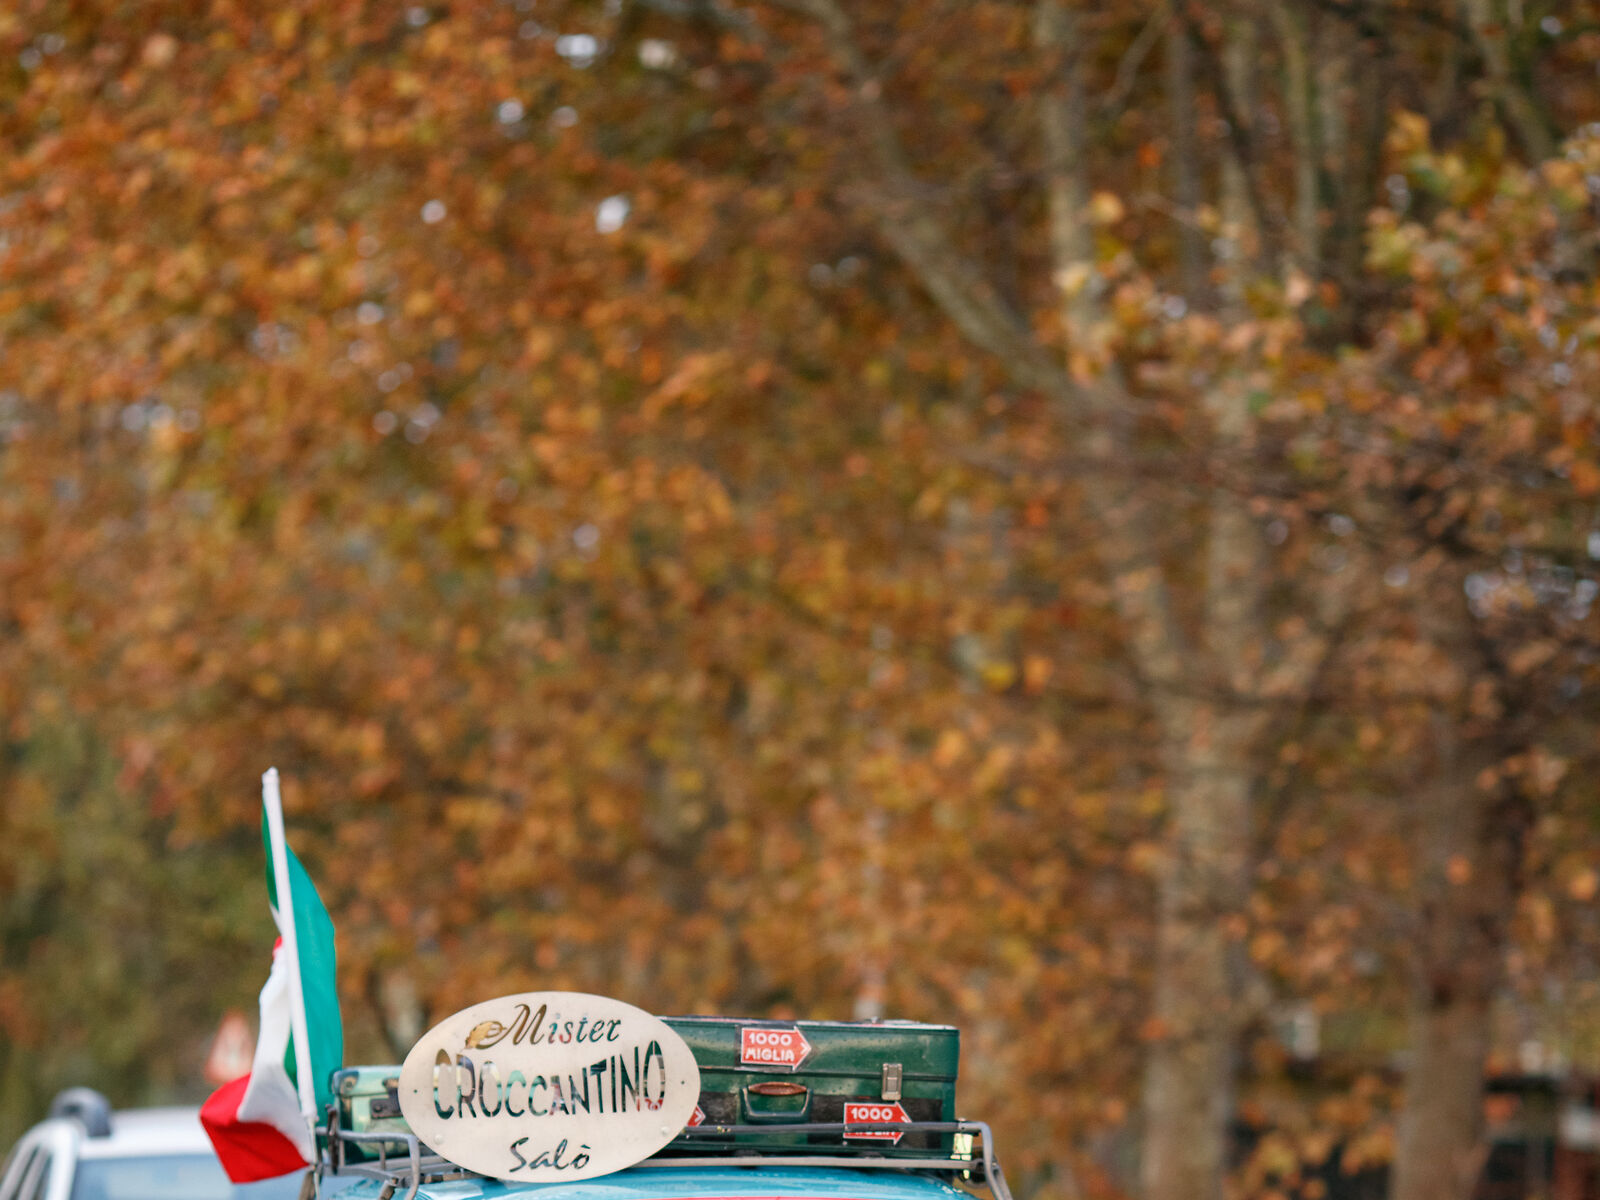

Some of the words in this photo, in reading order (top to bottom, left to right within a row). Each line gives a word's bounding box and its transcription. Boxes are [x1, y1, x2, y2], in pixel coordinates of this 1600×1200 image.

[473, 1003, 621, 1049] Mister
[749, 1033, 792, 1046] 1000
[745, 1048, 795, 1062] MIGLIA
[433, 1039, 666, 1119] CROCCANTINO
[851, 1108, 893, 1120] 1000
[509, 1137, 591, 1172] Salò
